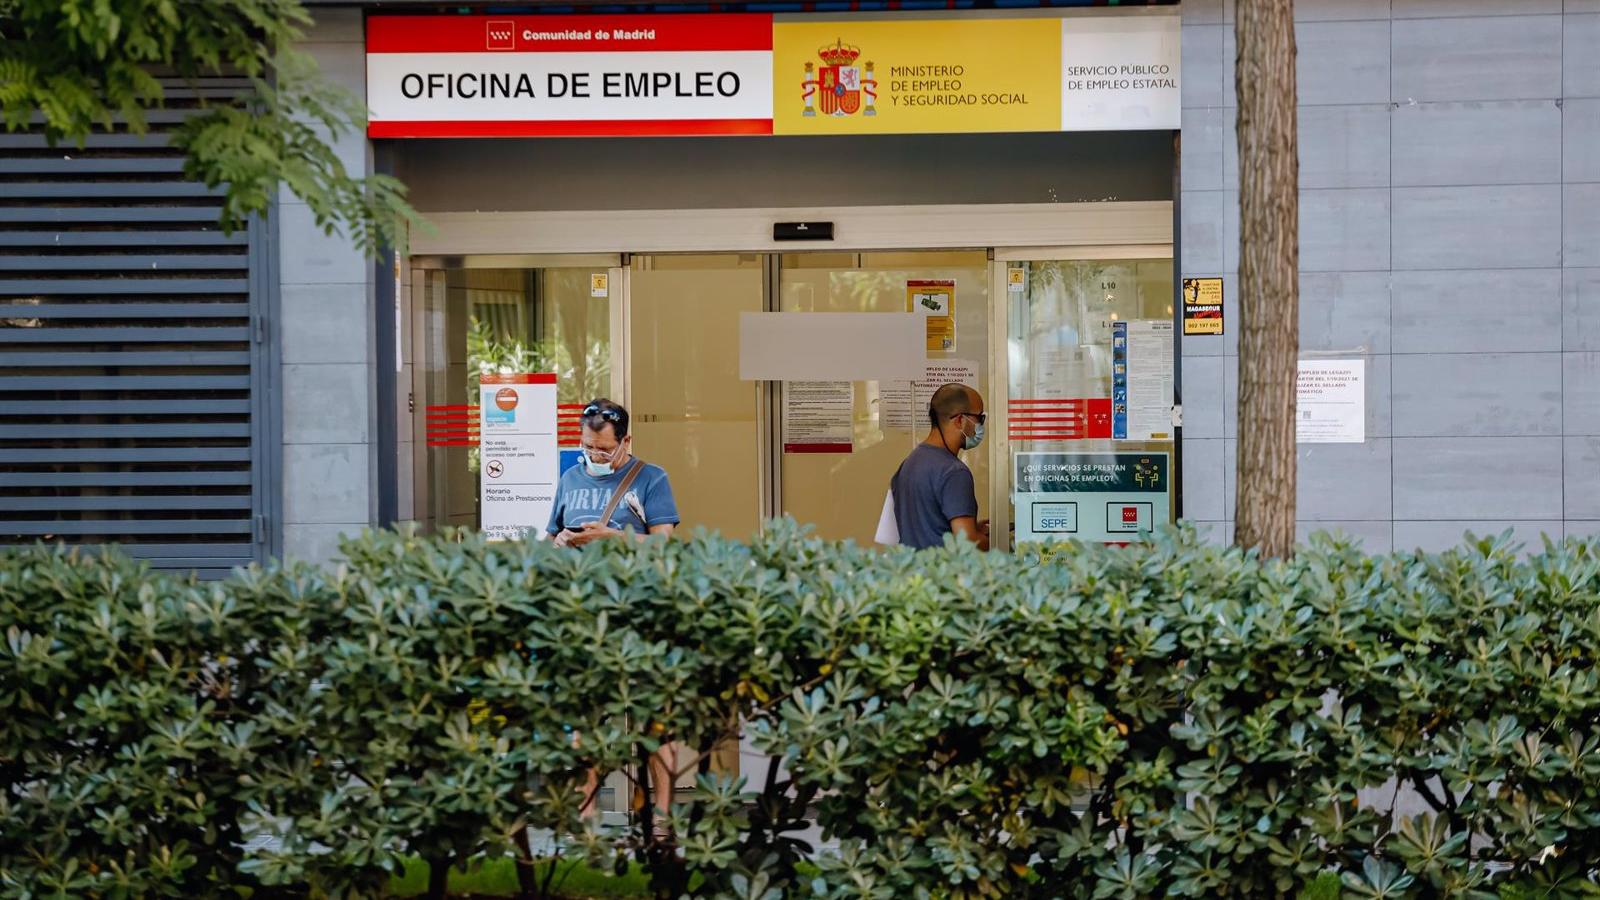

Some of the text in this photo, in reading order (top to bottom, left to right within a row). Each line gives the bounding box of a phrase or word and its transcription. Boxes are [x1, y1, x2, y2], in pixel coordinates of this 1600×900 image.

[523, 28, 656, 41] Comunidad de Madrid
[890, 65, 964, 77] MINISTERIO
[1068, 63, 1170, 76] SERVICIO PÚBLICO
[401, 70, 741, 100] OFICINA DE EMPLEO
[891, 80, 962, 92] DE EMPLEO
[1068, 78, 1178, 91] DE EMPLEO ESTATAL
[891, 93, 1028, 107] Y SEGURIDAD SOCIAL
[1042, 464, 1082, 472] SERVICIOS
[1083, 464, 1092, 472] SE
[1093, 463, 1126, 472] PRESTAN
[1024, 474, 1114, 482] EN OFICINAS DE EMPLEO?
[564, 487, 640, 511] NIRVA
[1041, 518, 1068, 529] SEPE
